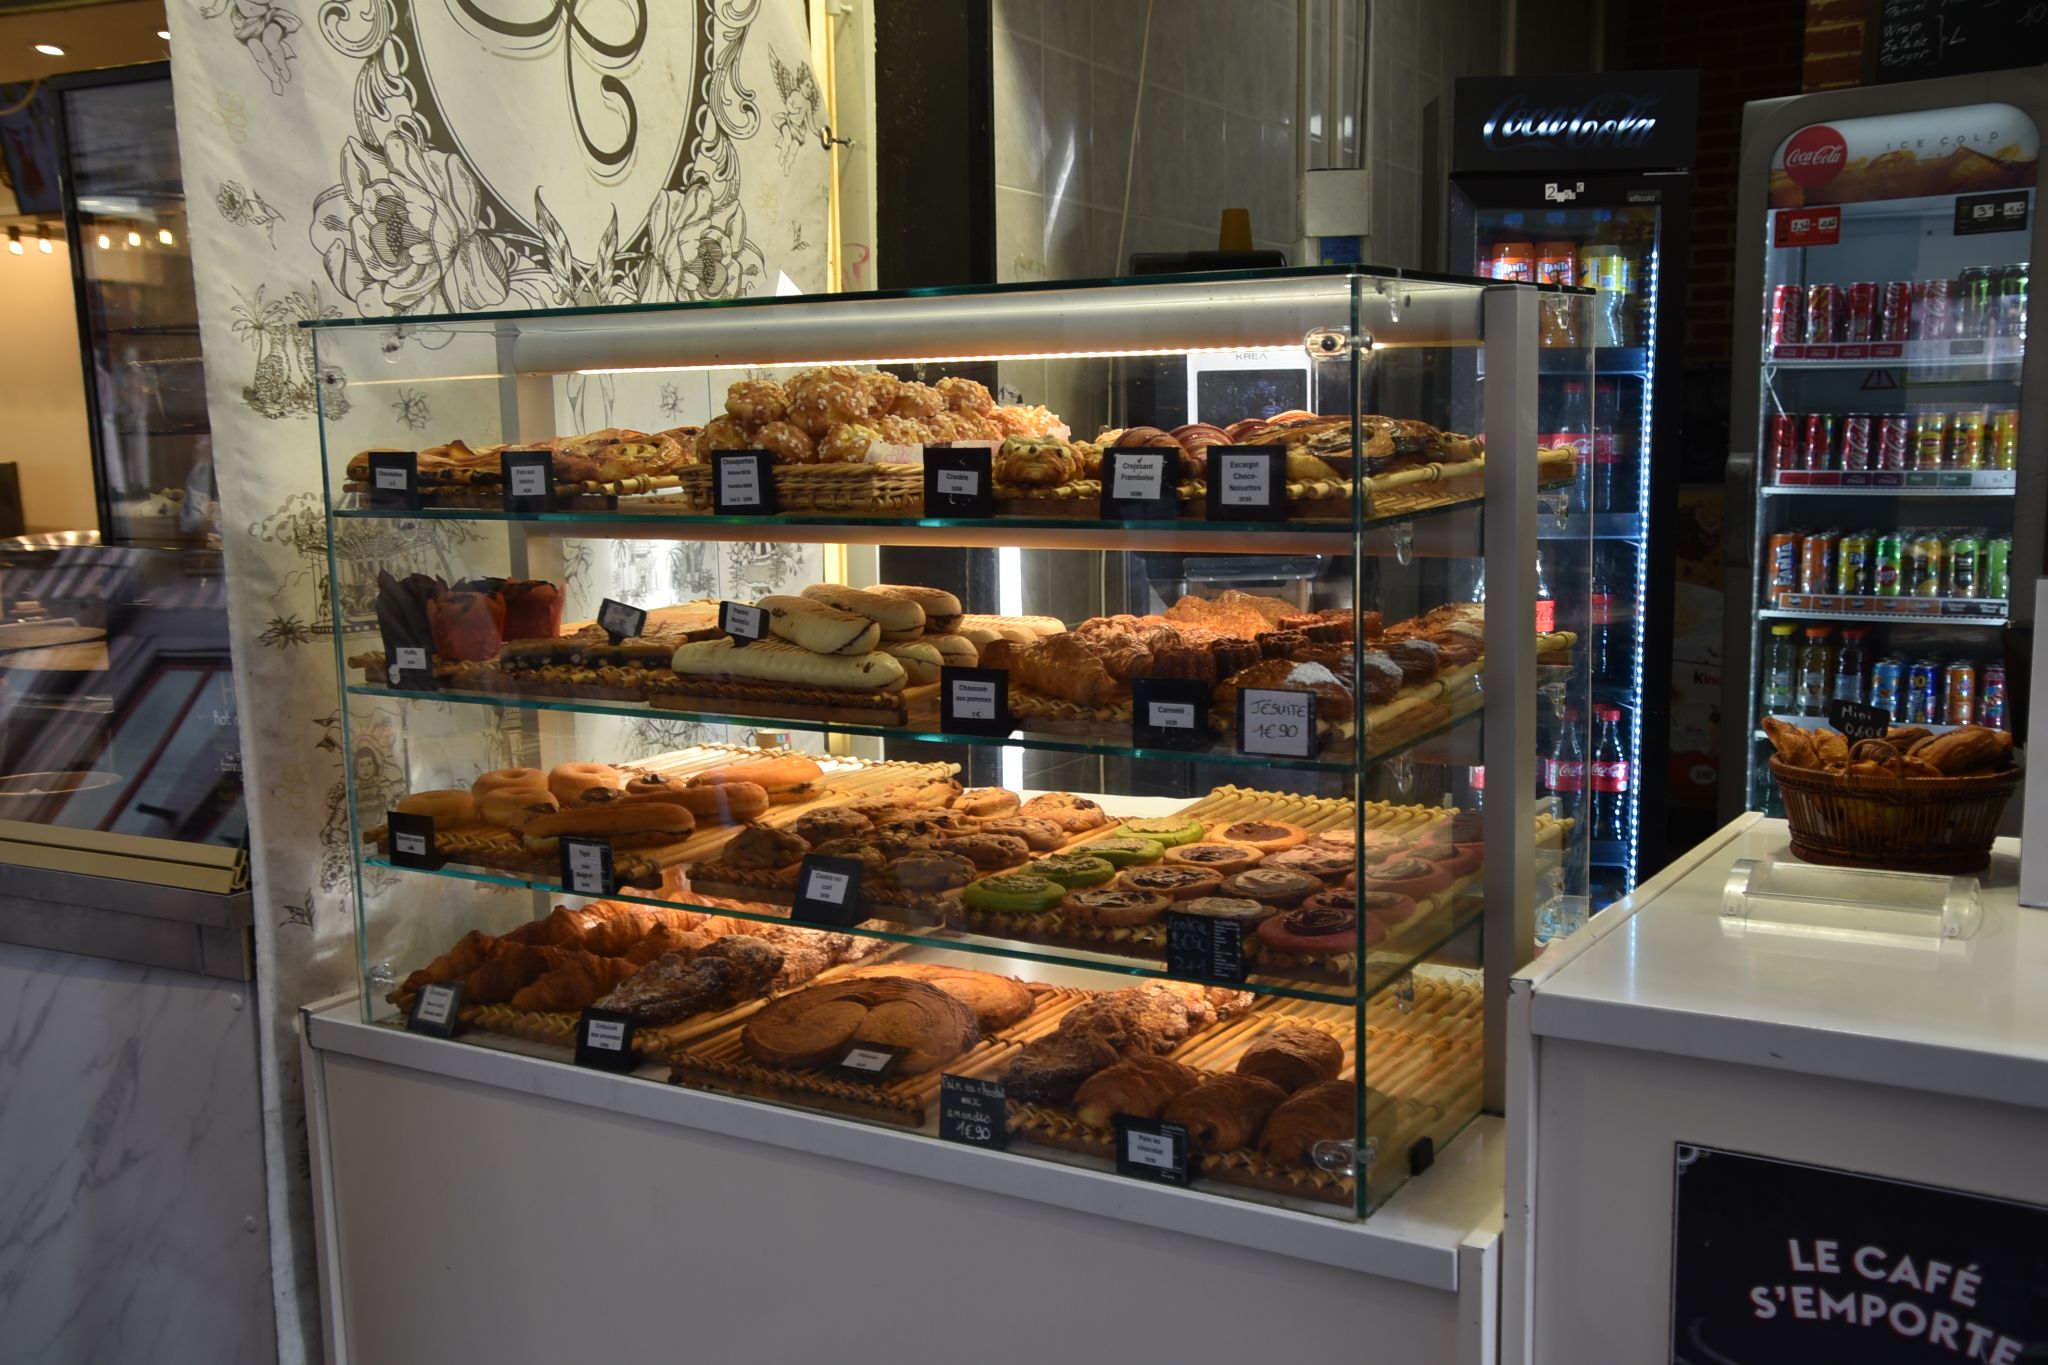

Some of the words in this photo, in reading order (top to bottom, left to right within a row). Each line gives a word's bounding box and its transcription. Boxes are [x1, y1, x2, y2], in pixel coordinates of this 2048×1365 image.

[1887, 139, 1924, 151] ICE
[1940, 131, 1999, 147] COLD
[1786, 144, 1845, 167] Coca-Cola
[1122, 462, 1154, 471] Croissant
[1230, 461, 1260, 470] Escargot
[1120, 473, 1155, 482] Framboise
[1233, 472, 1258, 480] Choco-
[1229, 484, 1262, 492] Noisettes
[1775, 542, 1793, 586] FANTA
[958, 684, 988, 693] Chausson
[966, 696, 992, 704] pommes
[1841, 705, 1872, 721] Mini
[1251, 724, 1299, 739] 1€90
[956, 1121, 993, 1141] 1€90
[1788, 1239, 1841, 1274] LE
[1853, 1246, 1982, 1307] CAFÉ
[1750, 1286, 2023, 1365] S'EMPORTE
